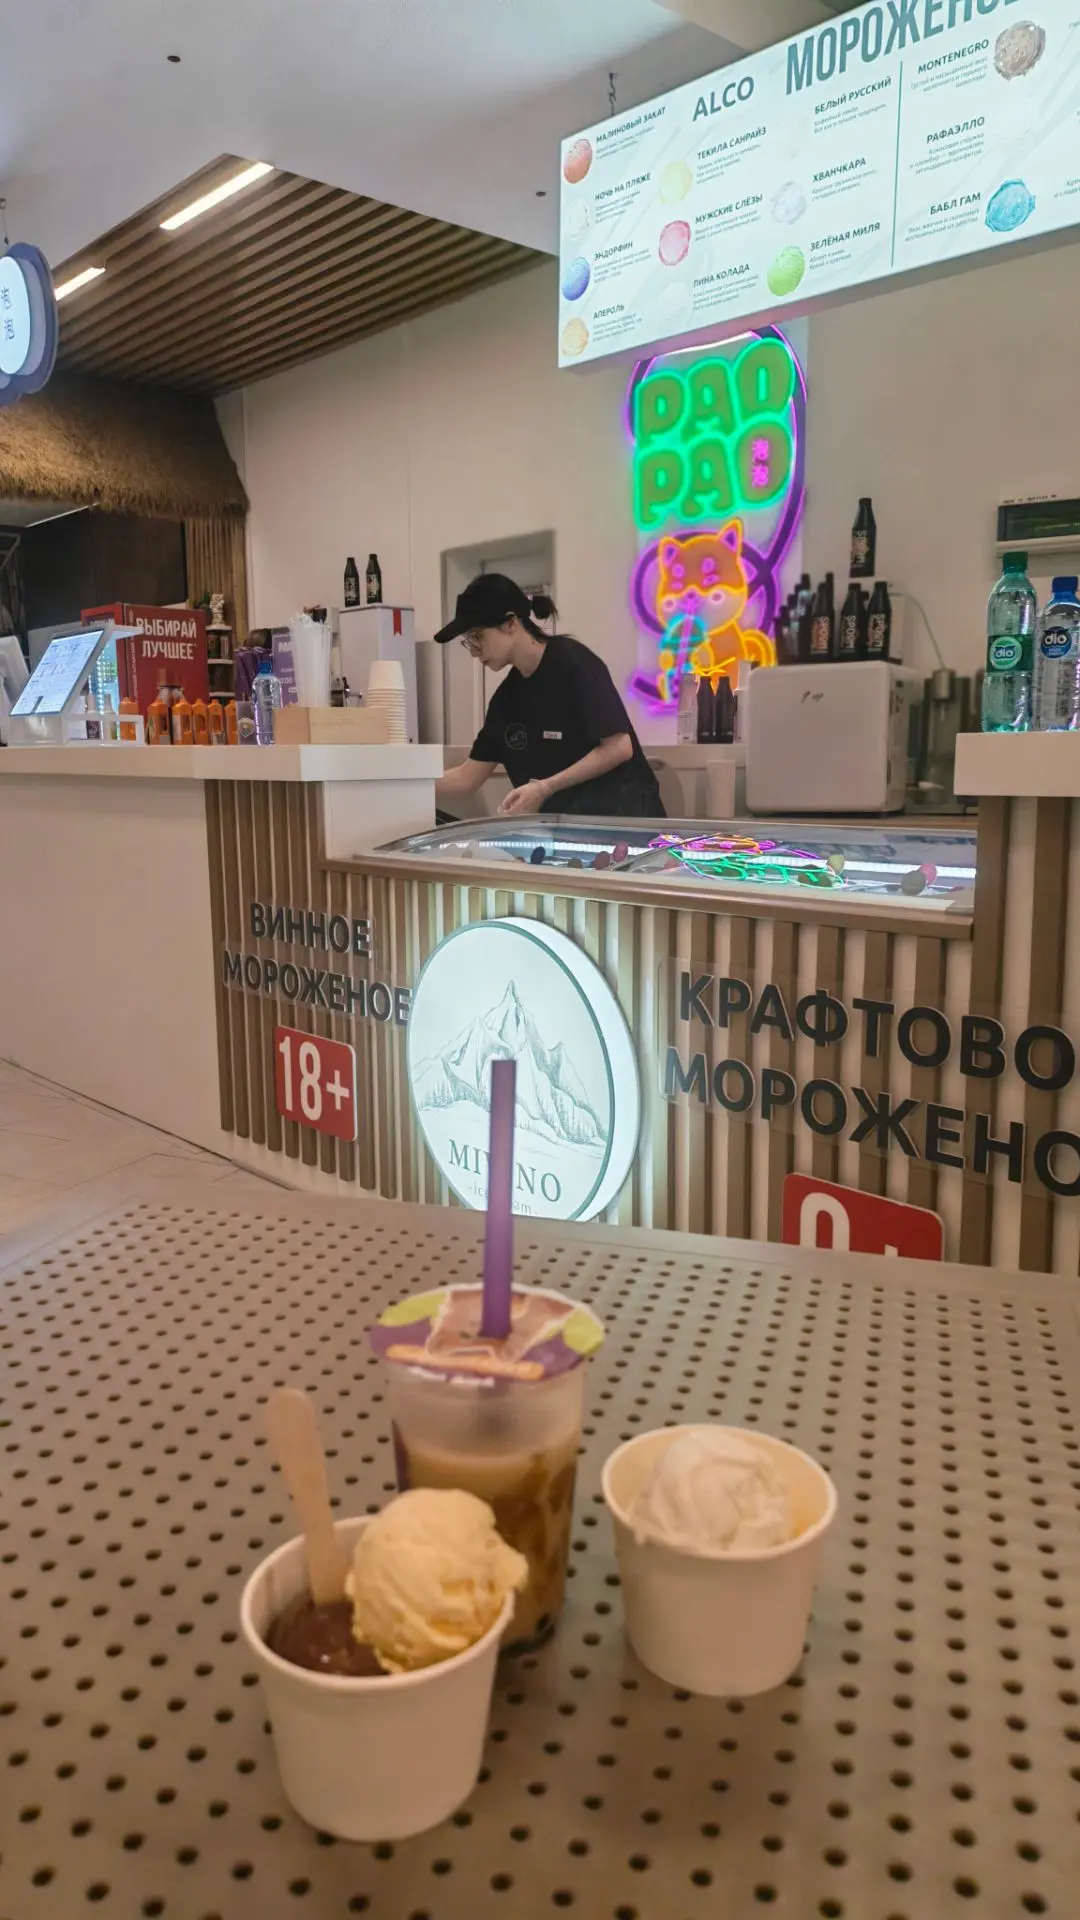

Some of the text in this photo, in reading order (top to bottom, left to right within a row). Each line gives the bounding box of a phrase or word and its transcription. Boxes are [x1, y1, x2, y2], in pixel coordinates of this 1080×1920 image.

[786, 0, 1019, 95] МОРОЖЕН
[918, 39, 989, 74] MONTENEGRO
[692, 76, 755, 121] ALCO
[814, 93, 847, 115] БЕЛЫЙ
[848, 75, 892, 101] РУССКИЙ
[595, 115, 642, 143] МАЛИНОВЫЙ
[643, 106, 666, 123] ЗАКАТ
[926, 116, 985, 144] РАФАЭЛЛО
[697, 126, 767, 160] ТЕКИЛА САНРАЙЗ
[812, 157, 866, 183] ХВАНЧКАРА
[594, 172, 651, 201] НОЧЬ НА ПЛЯЖЕ
[695, 193, 763, 224] МУЖСКИЕ СЛЁЗЫ
[930, 192, 981, 215] БАБЛ ГАМ
[594, 241, 634, 260] ЭНДОРФИН
[810, 222, 881, 252] ЗЕЛЁНАЯ МИЛЯ
[693, 263, 750, 288] ПИНА КОЛАДА
[593, 303, 625, 320] АПЕРОЛЬ
[136, 617, 197, 638] ВЫБИРАЙ
[1044, 632, 1068, 645] dio
[995, 645, 1014, 658] dio
[250, 901, 373, 960] ВИННОЕ
[222, 949, 413, 1026] МОРОЖЕНОЕ
[679, 971, 1076, 1092] КРАФТОВО
[278, 1035, 350, 1121] 18+
[663, 1046, 1080, 1197] МОРОЖЕНО
